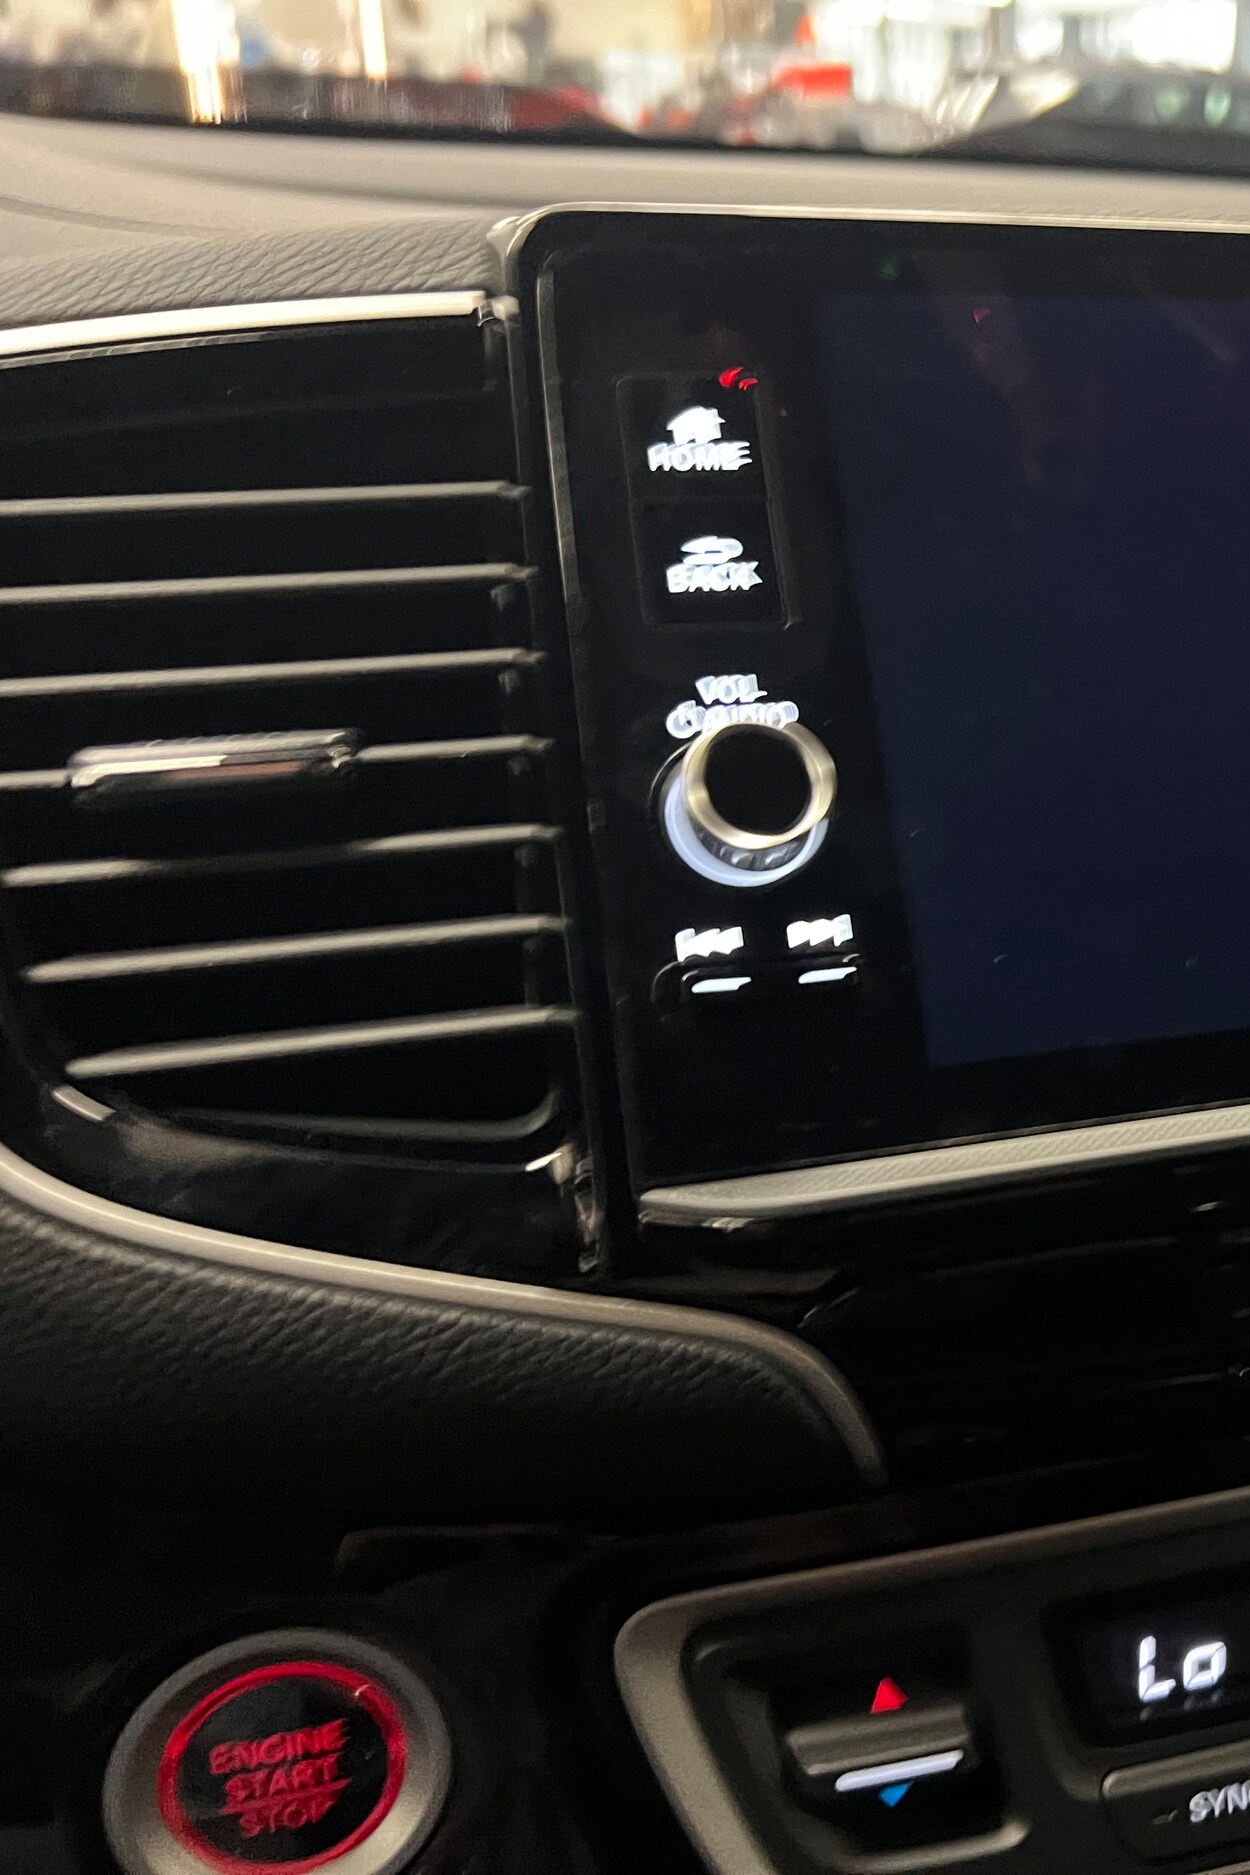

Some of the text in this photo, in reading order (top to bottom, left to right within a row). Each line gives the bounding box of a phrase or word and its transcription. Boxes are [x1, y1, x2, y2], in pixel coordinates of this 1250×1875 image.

[647, 440, 752, 471] HOME
[665, 560, 763, 593] BACK
[695, 673, 768, 704] VOL
[1138, 1635, 1228, 1703] Lo
[208, 1719, 350, 1775] ENGINE
[224, 1753, 339, 1801] START
